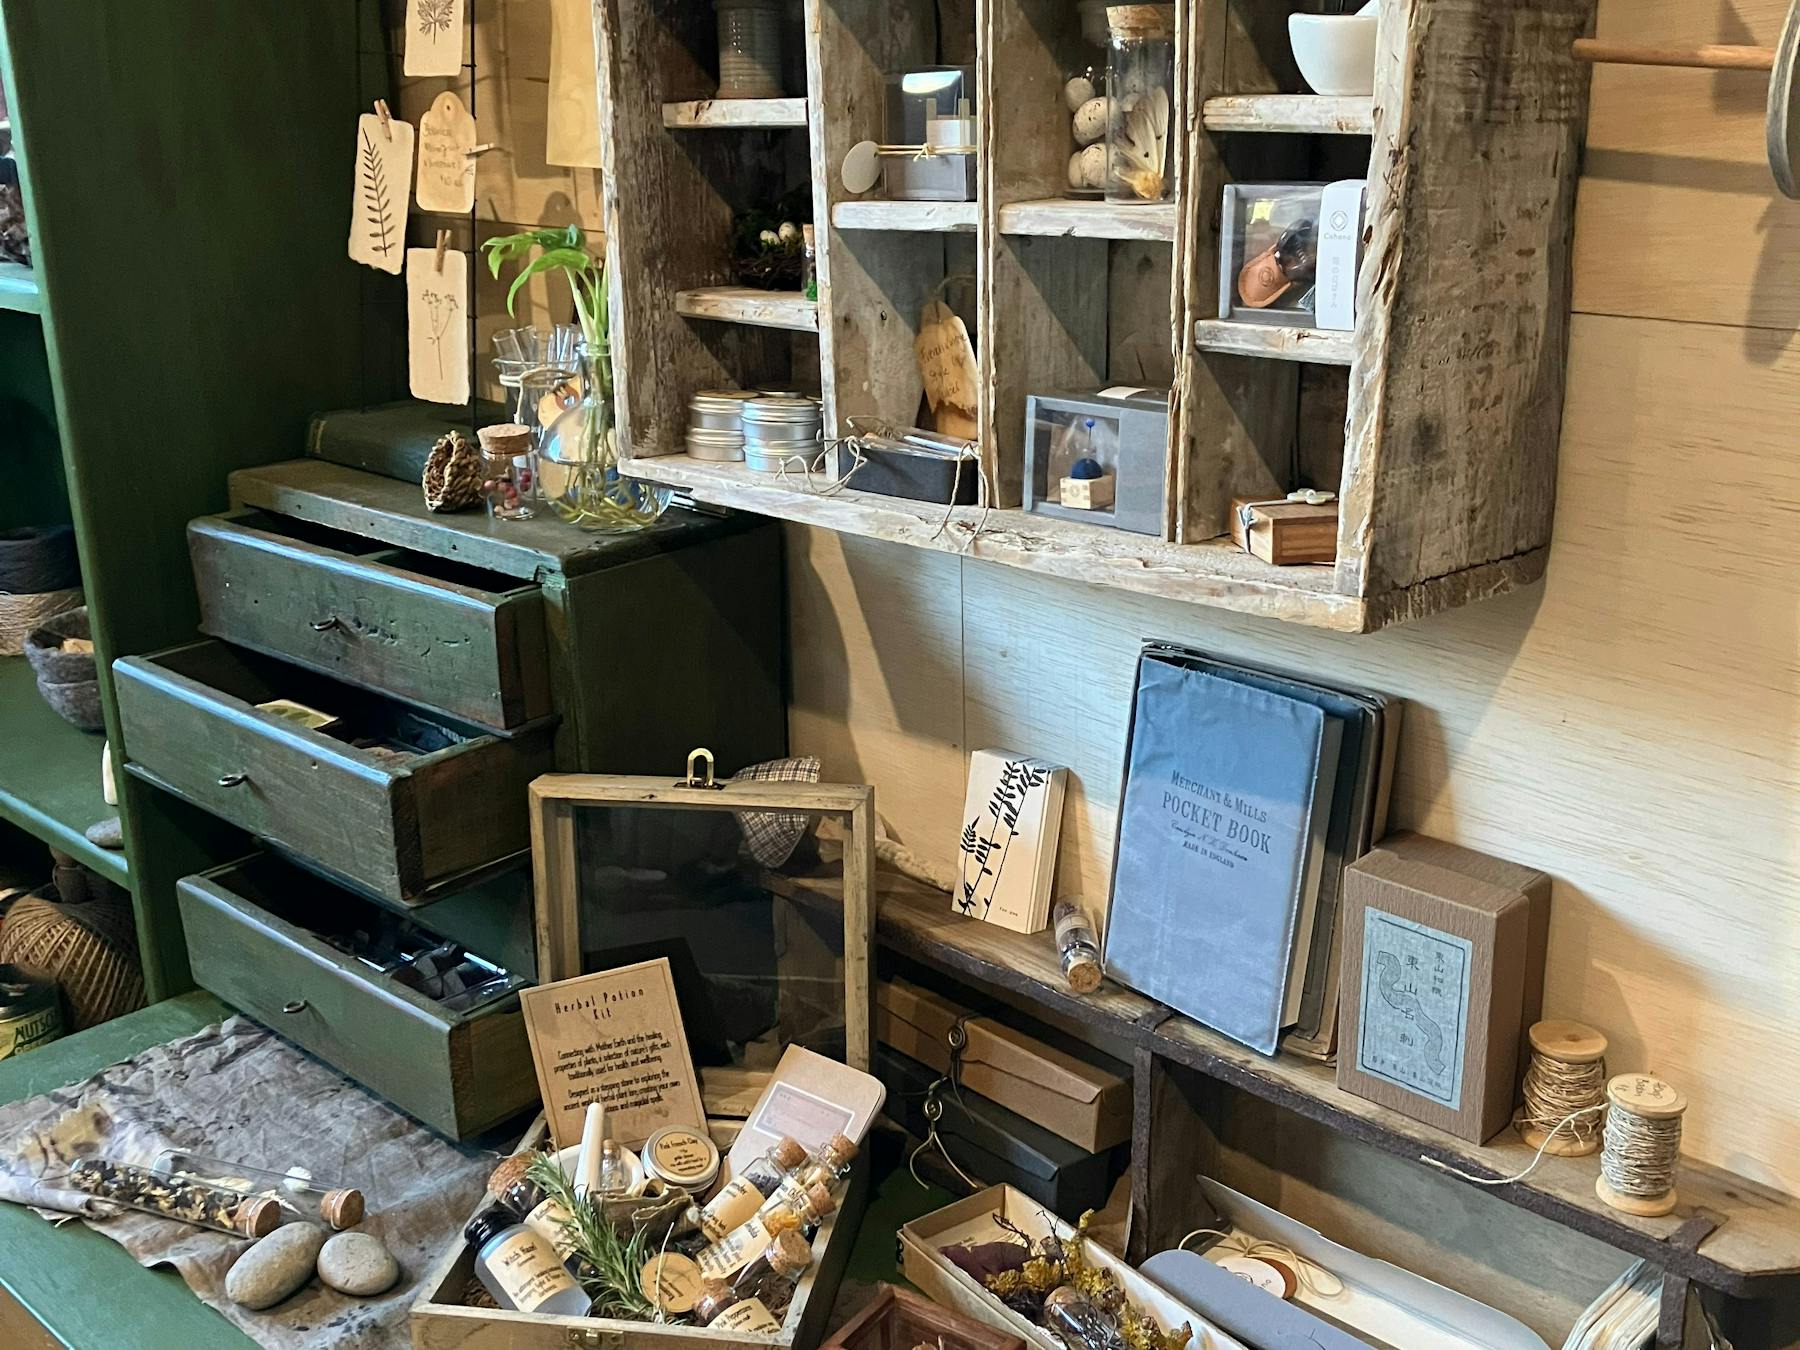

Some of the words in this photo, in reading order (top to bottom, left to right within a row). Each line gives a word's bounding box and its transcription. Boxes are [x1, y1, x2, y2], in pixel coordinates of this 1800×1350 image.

[1171, 769, 1221, 804] MERCHANT
[1223, 793, 1232, 808] &
[1235, 797, 1267, 823] MILLS
[1162, 790, 1222, 832] POCKET
[1226, 818, 1271, 854] BOOK
[1182, 840, 1199, 853] MADE
[1200, 847, 1208, 856] IN
[1209, 851, 1235, 869] ENGLAND
[554, 995, 596, 1014] Herbal
[603, 988, 644, 1003] Potion
[593, 1007, 612, 1020] Kit
[578, 1058, 582, 1067] of
[624, 1047, 629, 1057] of
[660, 1038, 672, 1048] each
[585, 1044, 596, 1054] with
[596, 1041, 613, 1051] Mother
[613, 1038, 627, 1048] Earth
[627, 1035, 636, 1045] and
[636, 1034, 644, 1043] the
[595, 1065, 606, 1075] used
[614, 1060, 629, 1070] health
[630, 1057, 639, 1067] and
[634, 1076, 640, 1084] to
[662, 1068, 670, 1078] the
[670, 1139, 687, 1147] French
